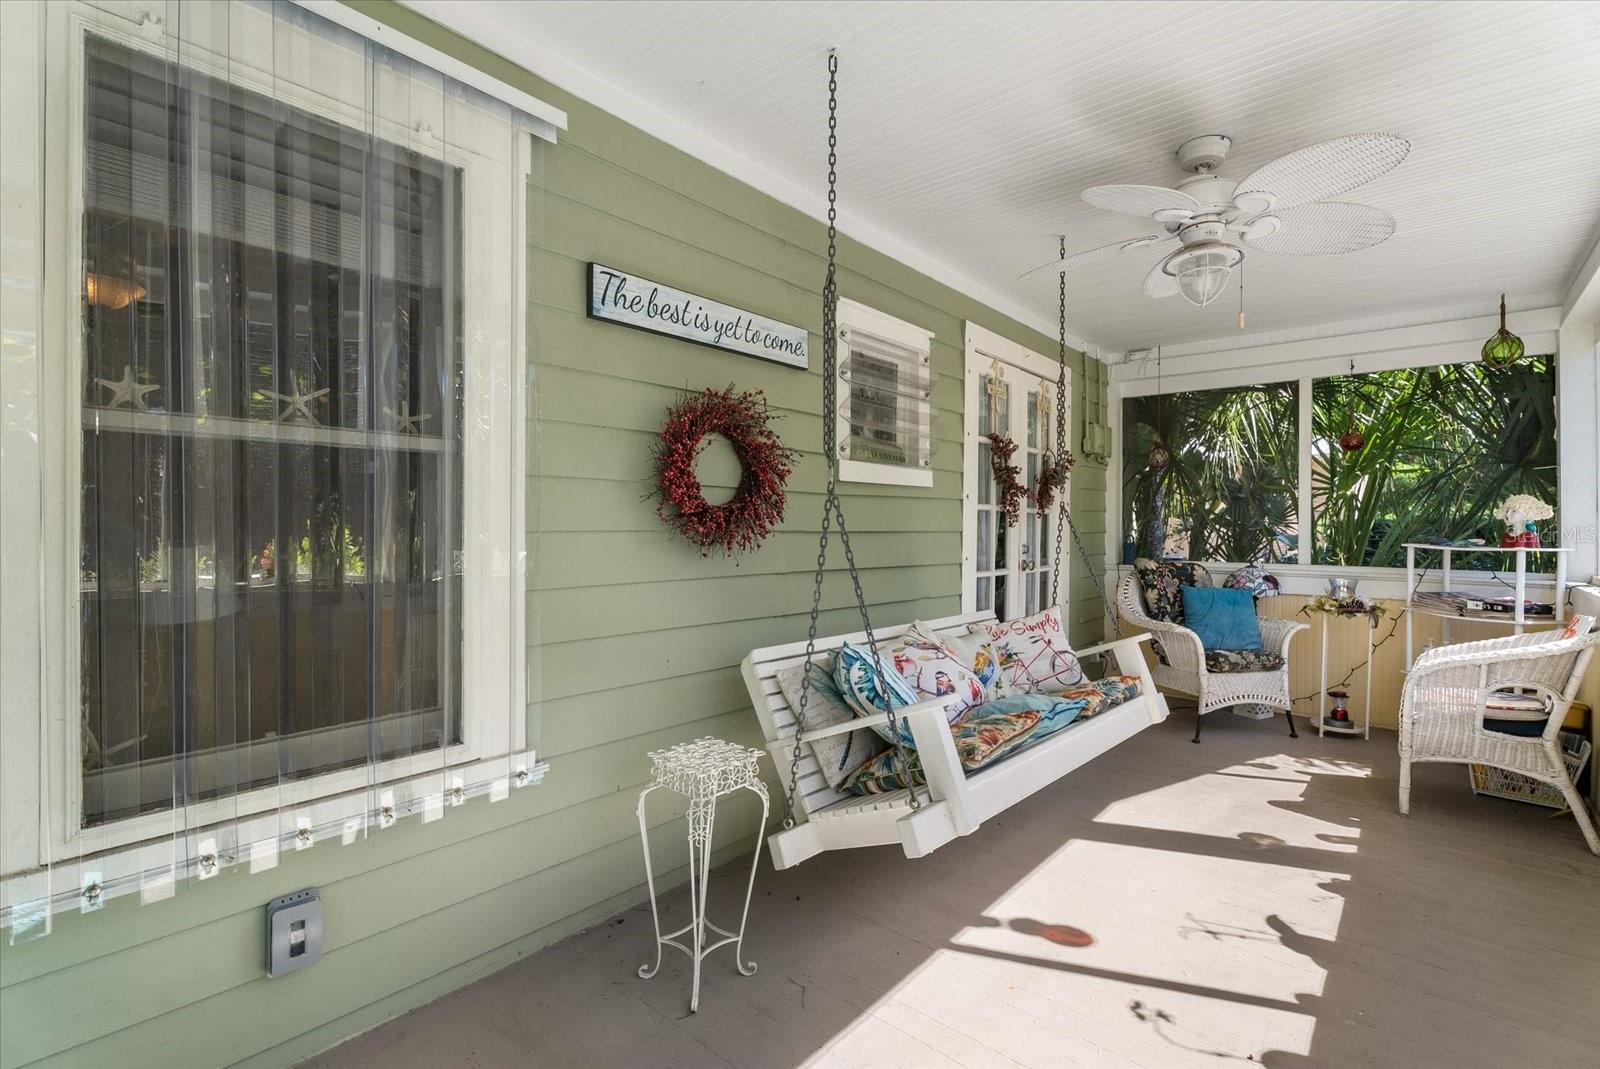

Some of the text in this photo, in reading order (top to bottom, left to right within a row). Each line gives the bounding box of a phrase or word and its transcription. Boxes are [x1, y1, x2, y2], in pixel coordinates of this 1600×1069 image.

[600, 271, 805, 357] The best is yet to come.
[1010, 613, 1060, 636] Simply
